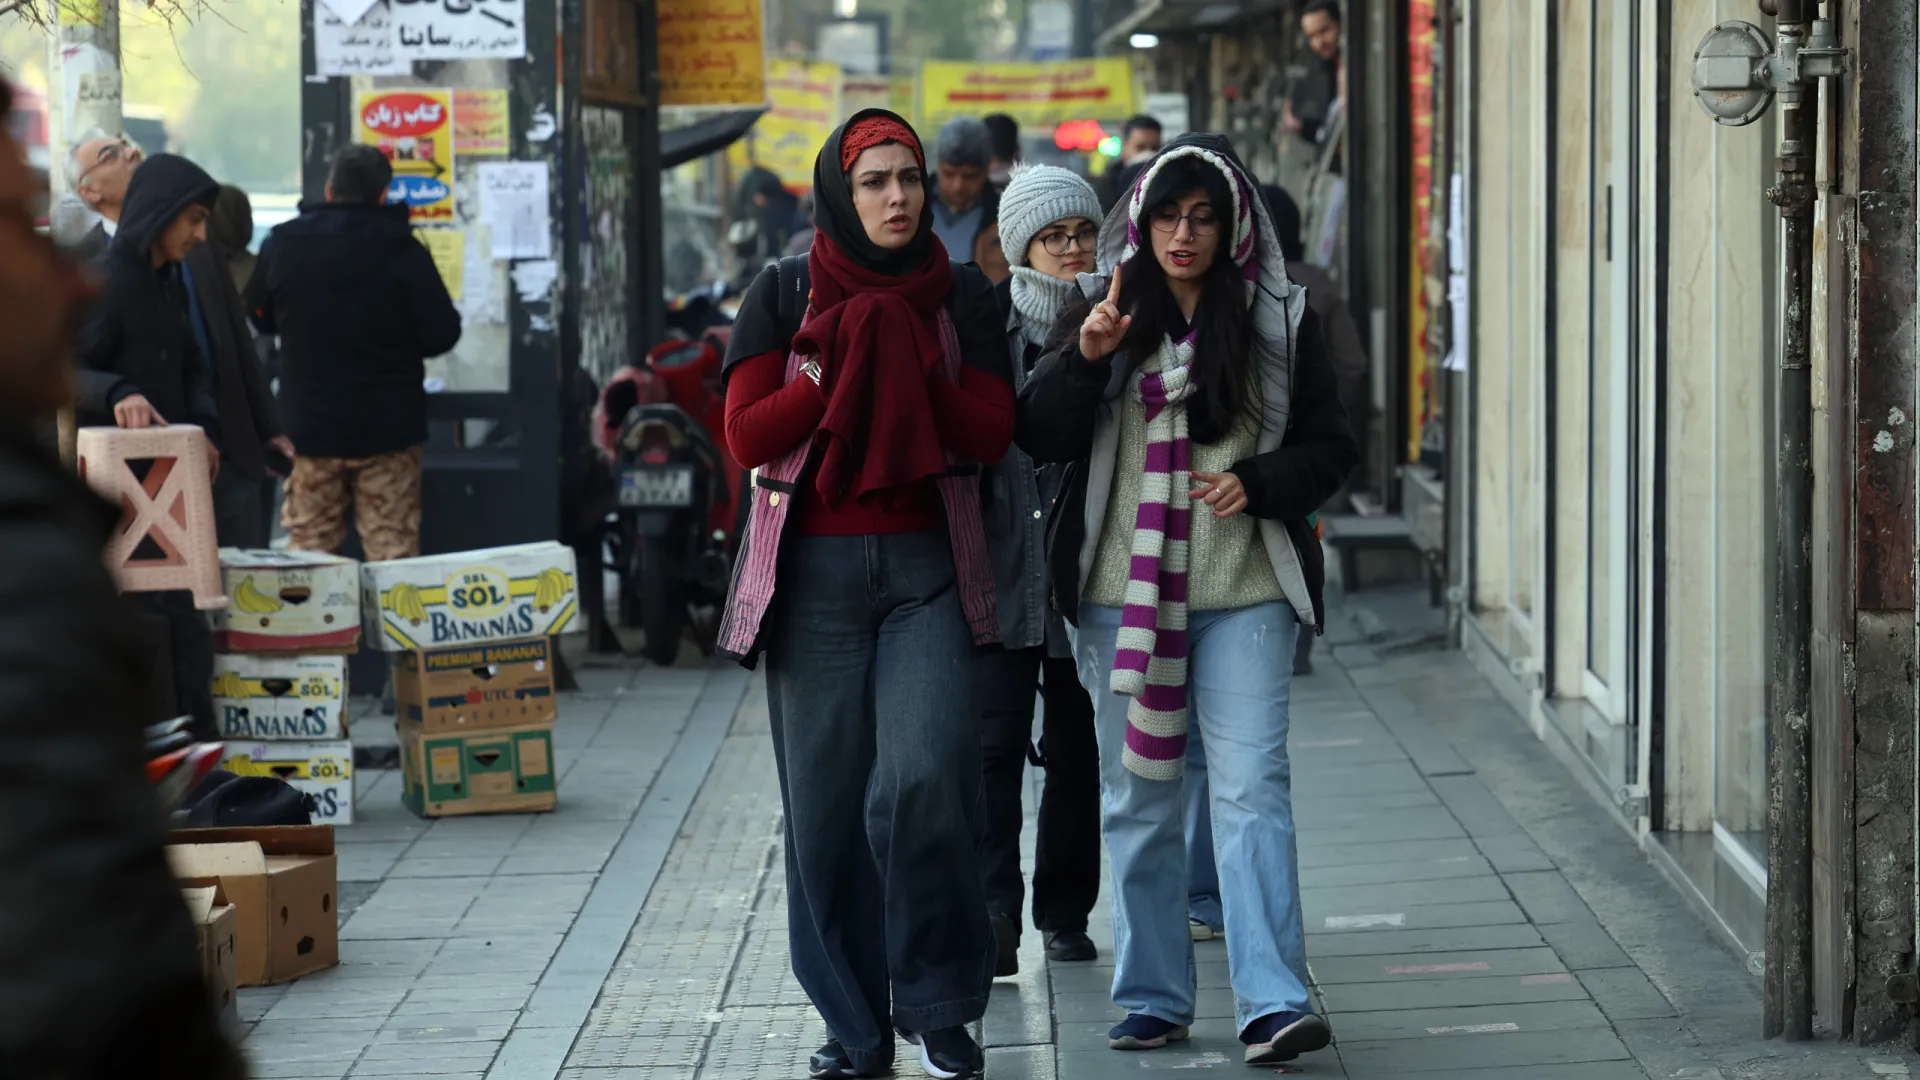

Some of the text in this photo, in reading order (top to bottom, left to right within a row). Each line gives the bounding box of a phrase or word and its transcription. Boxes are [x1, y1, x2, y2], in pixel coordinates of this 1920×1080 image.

[399, 24, 452, 54] ساینا
[364, 102, 402, 129] زبان
[403, 102, 443, 128] کتاب
[409, 181, 448, 200] نصف
[452, 585, 505, 608] SOL
[430, 603, 534, 643] BANANAS
[427, 645, 544, 668] PREMIUM BANANAS
[301, 684, 333, 697] SOL
[223, 704, 327, 737] BANANAS
[310, 768, 345, 777] SOL
